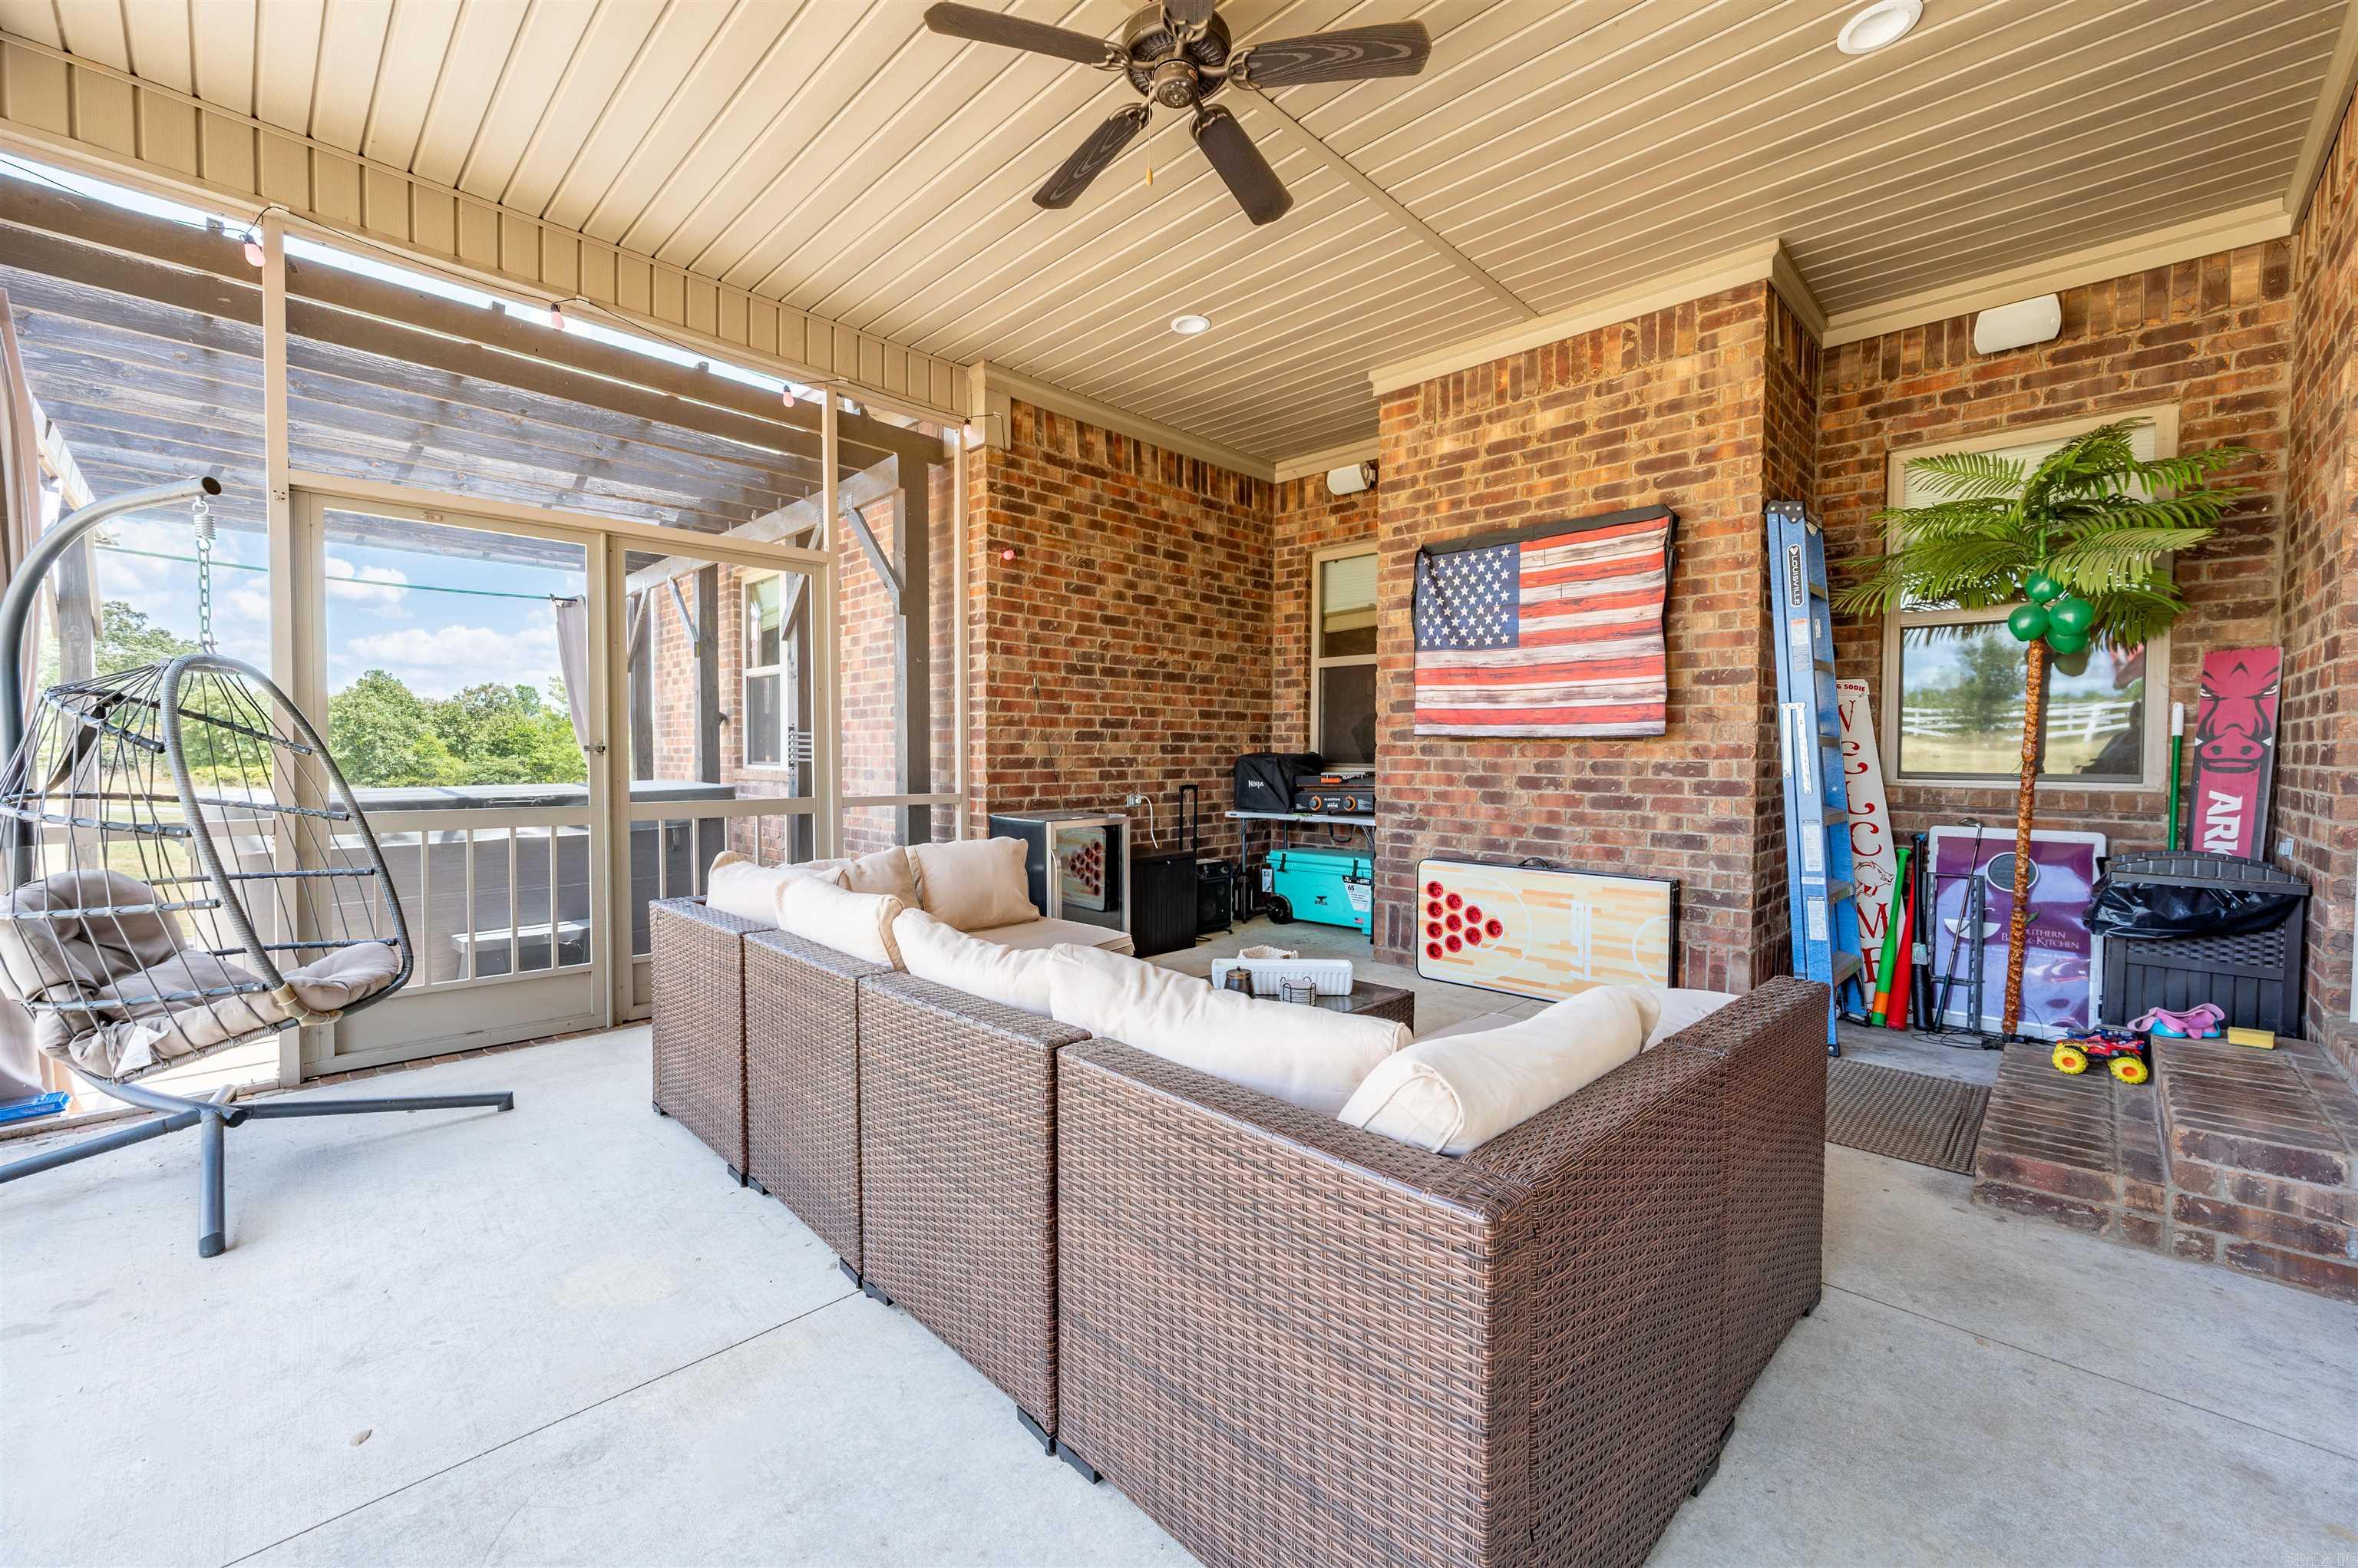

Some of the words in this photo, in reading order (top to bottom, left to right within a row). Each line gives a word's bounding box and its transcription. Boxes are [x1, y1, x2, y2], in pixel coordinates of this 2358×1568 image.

[1791, 555, 1801, 606] LOUISVILLE
[1844, 684, 1866, 692] SOOIE
[1248, 780, 1264, 789] NINJA
[2036, 936, 2079, 949] KITCHEN
